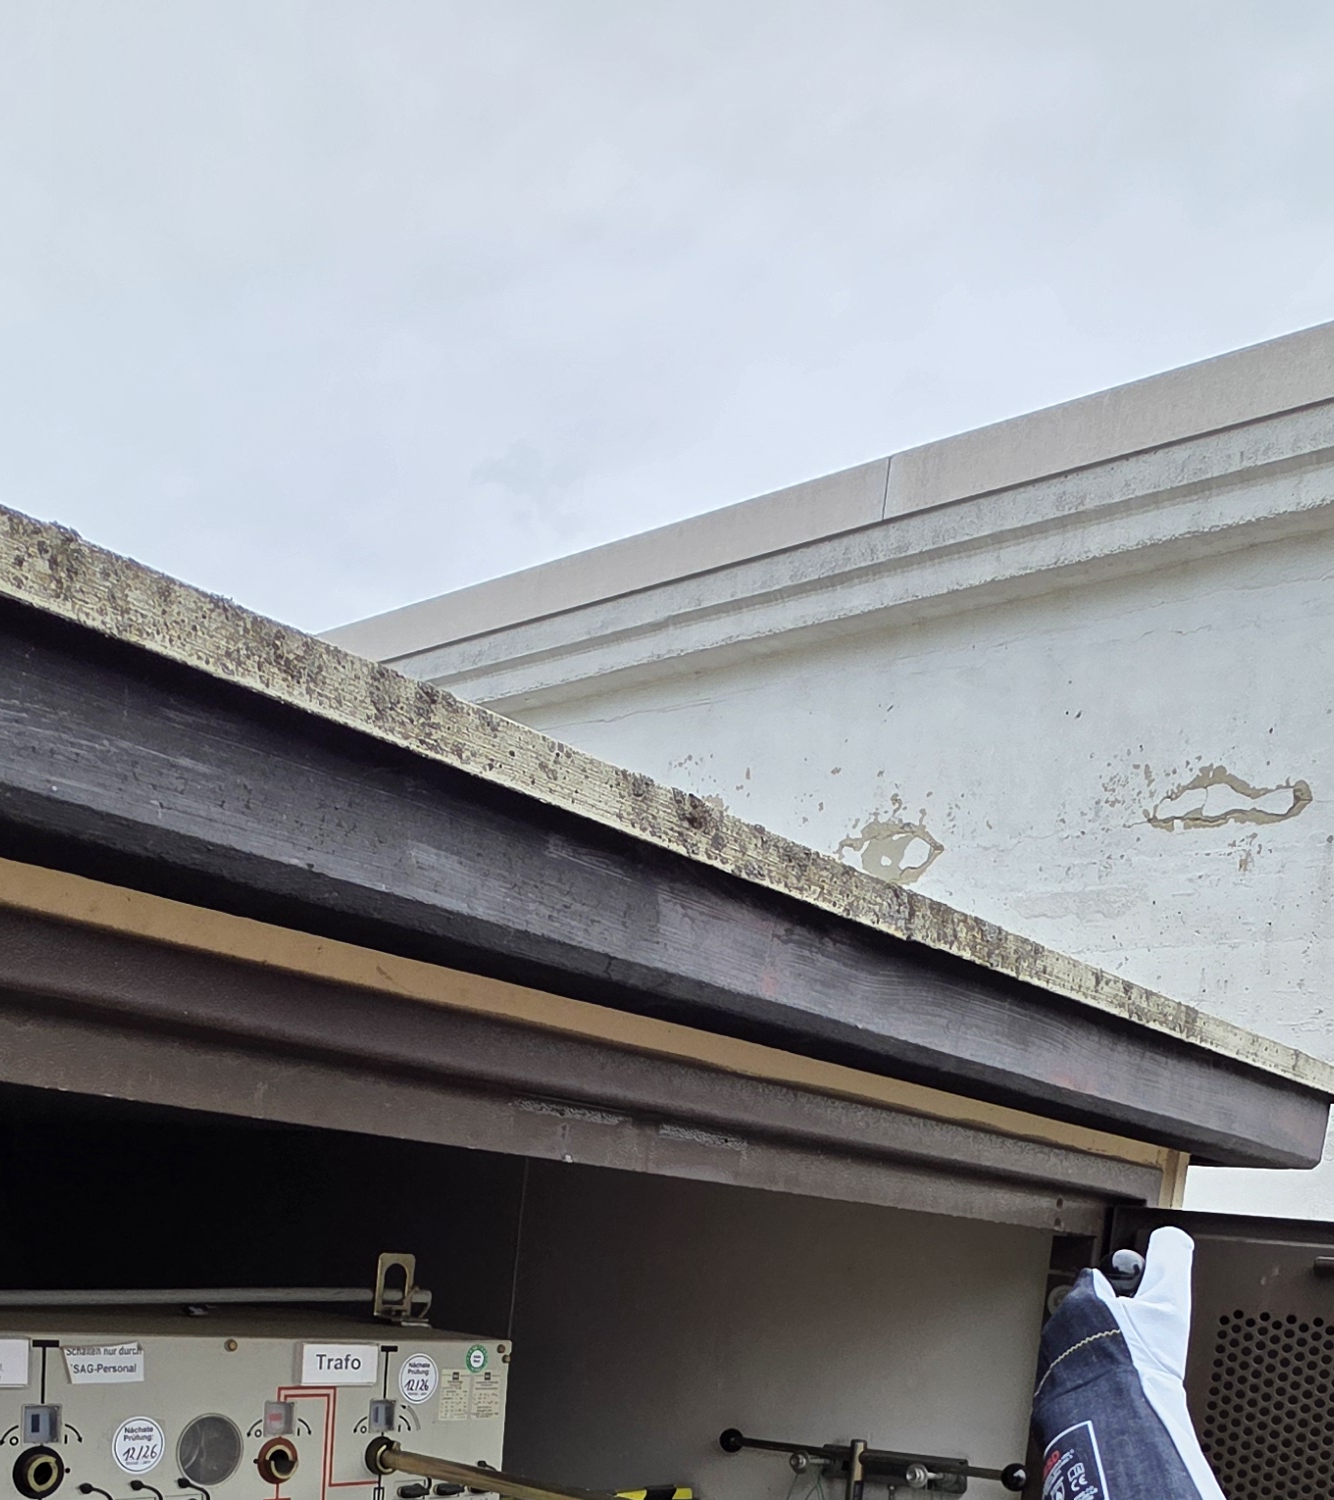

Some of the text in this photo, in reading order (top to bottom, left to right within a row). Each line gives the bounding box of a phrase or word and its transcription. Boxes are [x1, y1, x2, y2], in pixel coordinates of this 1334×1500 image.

[104, 1347, 117, 1355] nur
[71, 1363, 137, 1374] SAG-Personal
[316, 1354, 362, 1371] Trafo
[404, 1378, 429, 1391] 12/26
[123, 1444, 158, 1461] 12/26
